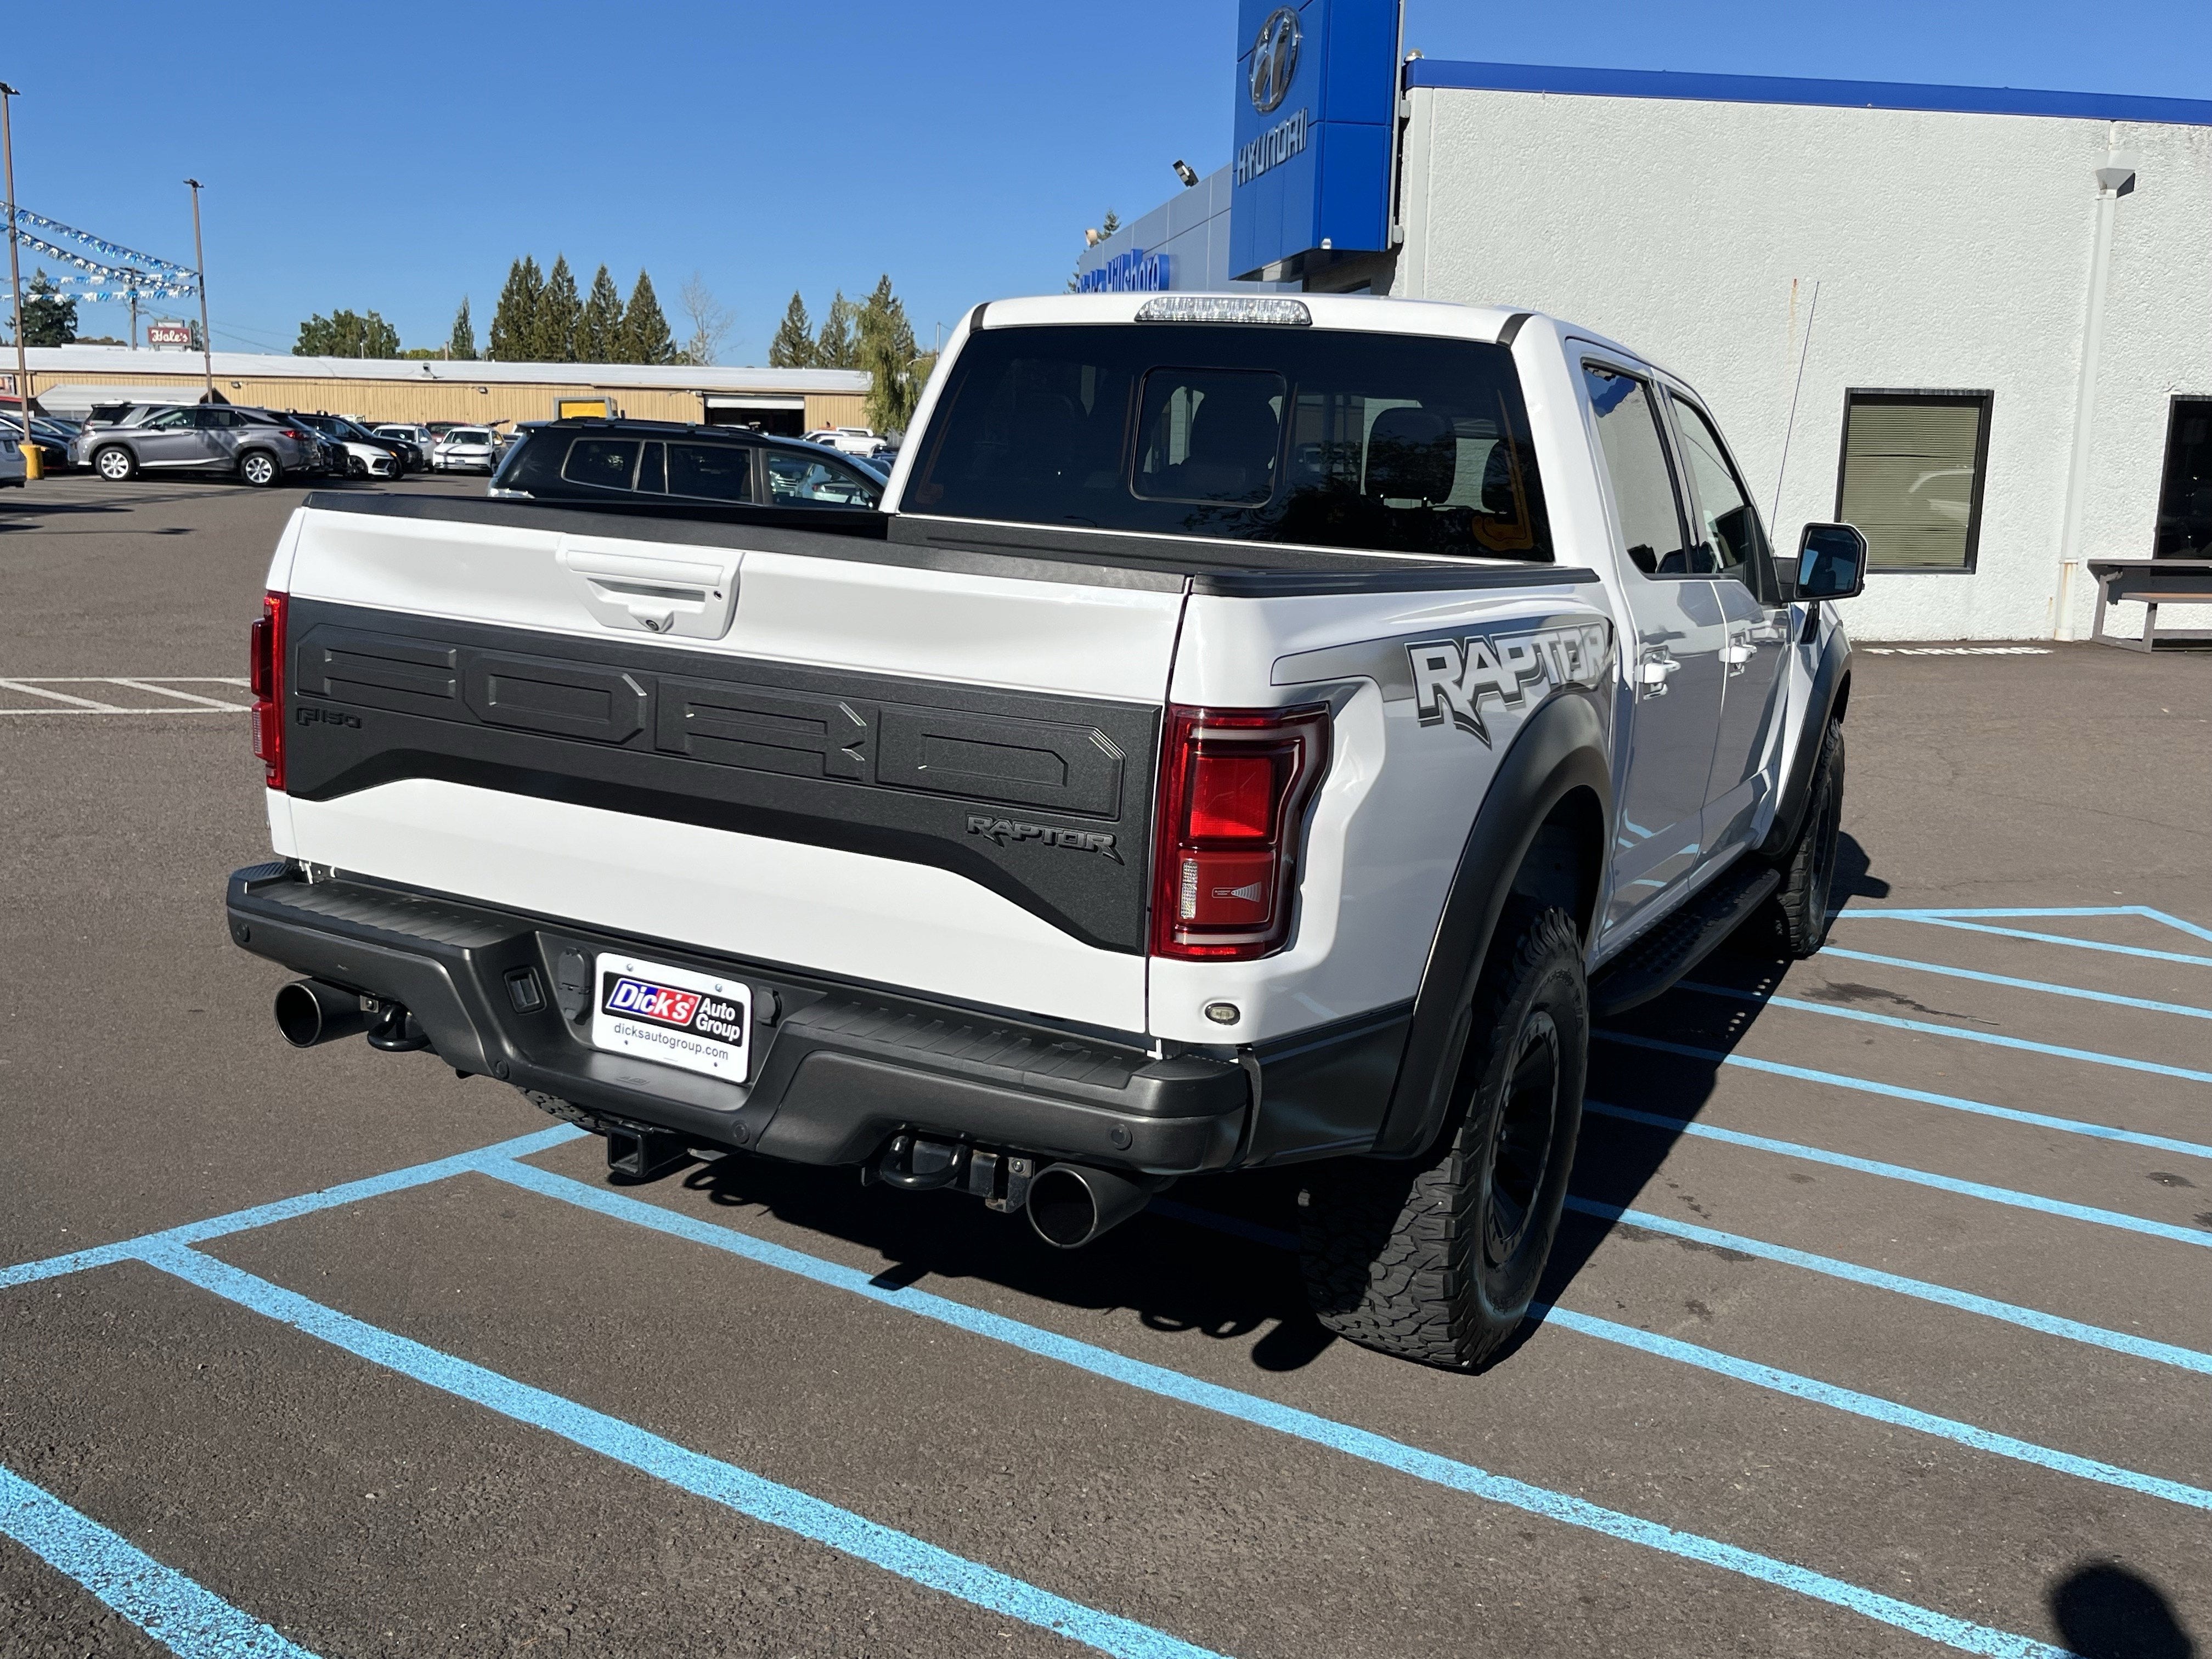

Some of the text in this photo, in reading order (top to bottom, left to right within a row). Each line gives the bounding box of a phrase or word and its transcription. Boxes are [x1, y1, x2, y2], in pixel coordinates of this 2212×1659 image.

[1237, 108, 1308, 187] HYUNDAI
[151, 329, 188, 343] Hale's
[1404, 622, 1609, 751] RAPTOR
[297, 622, 1127, 821] FORD
[966, 812, 1125, 866] RAPTOR
[613, 982, 691, 1021] Dick's
[699, 997, 736, 1021] Auto
[614, 1023, 729, 1060] dicksautogroup.com
[696, 1013, 741, 1041] Group
